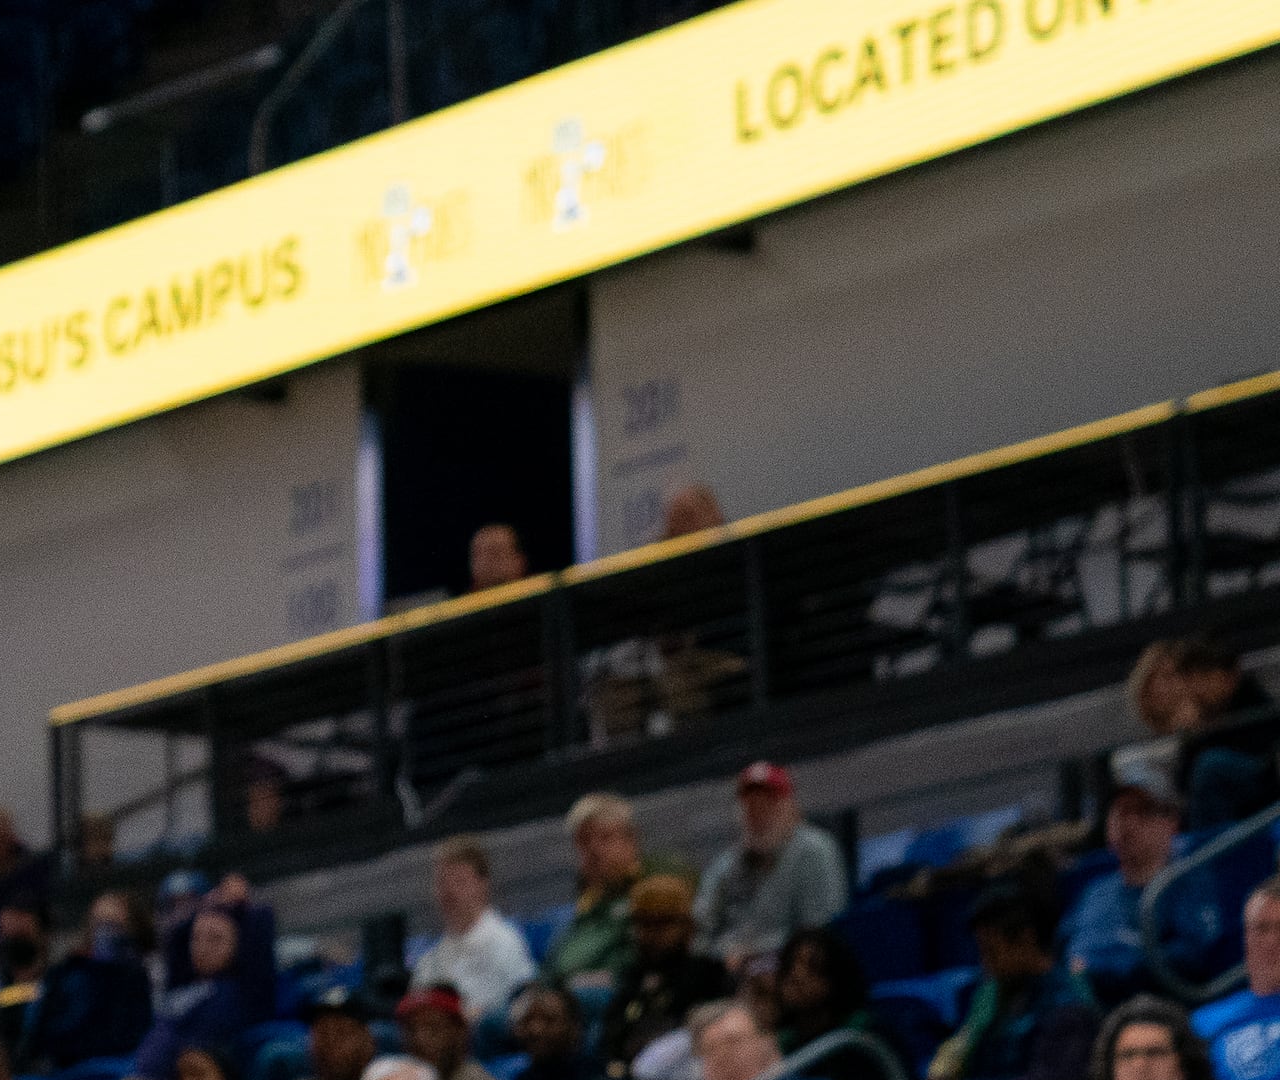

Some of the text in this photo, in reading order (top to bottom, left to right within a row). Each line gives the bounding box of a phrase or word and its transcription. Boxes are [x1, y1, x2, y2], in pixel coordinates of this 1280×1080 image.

[734, 0, 1112, 142] LOCATED O
[103, 236, 301, 355] CAMPUS
